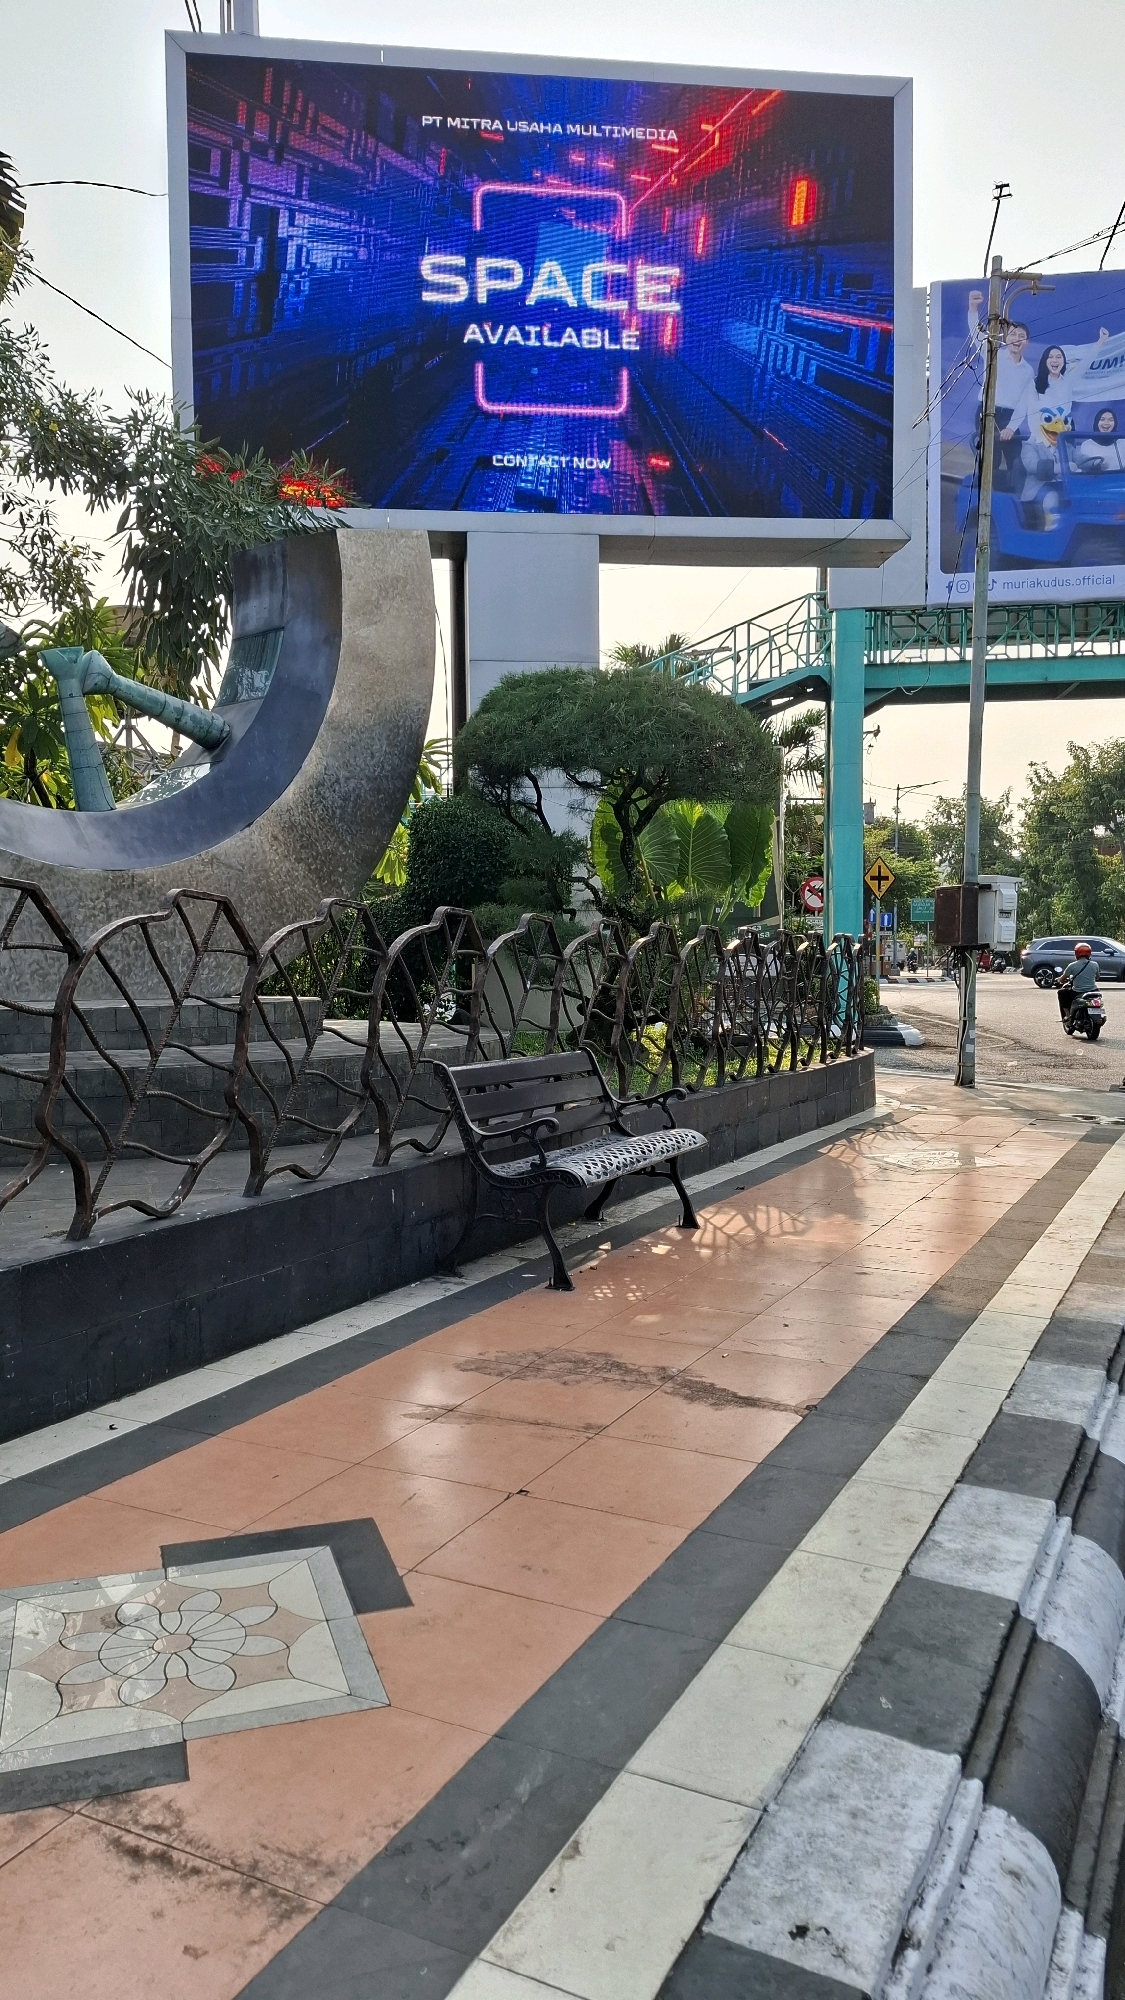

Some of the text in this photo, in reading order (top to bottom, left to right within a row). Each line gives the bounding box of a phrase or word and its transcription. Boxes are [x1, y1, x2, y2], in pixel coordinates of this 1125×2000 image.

[422, 115, 678, 141] PT MITRA USAHA MULTIMEDIA
[420, 254, 682, 312] SPACE
[463, 323, 640, 350] AVAILABLE
[492, 454, 612, 469] CONTACT NOW
[1002, 574, 1115, 590] muriakudus.official
